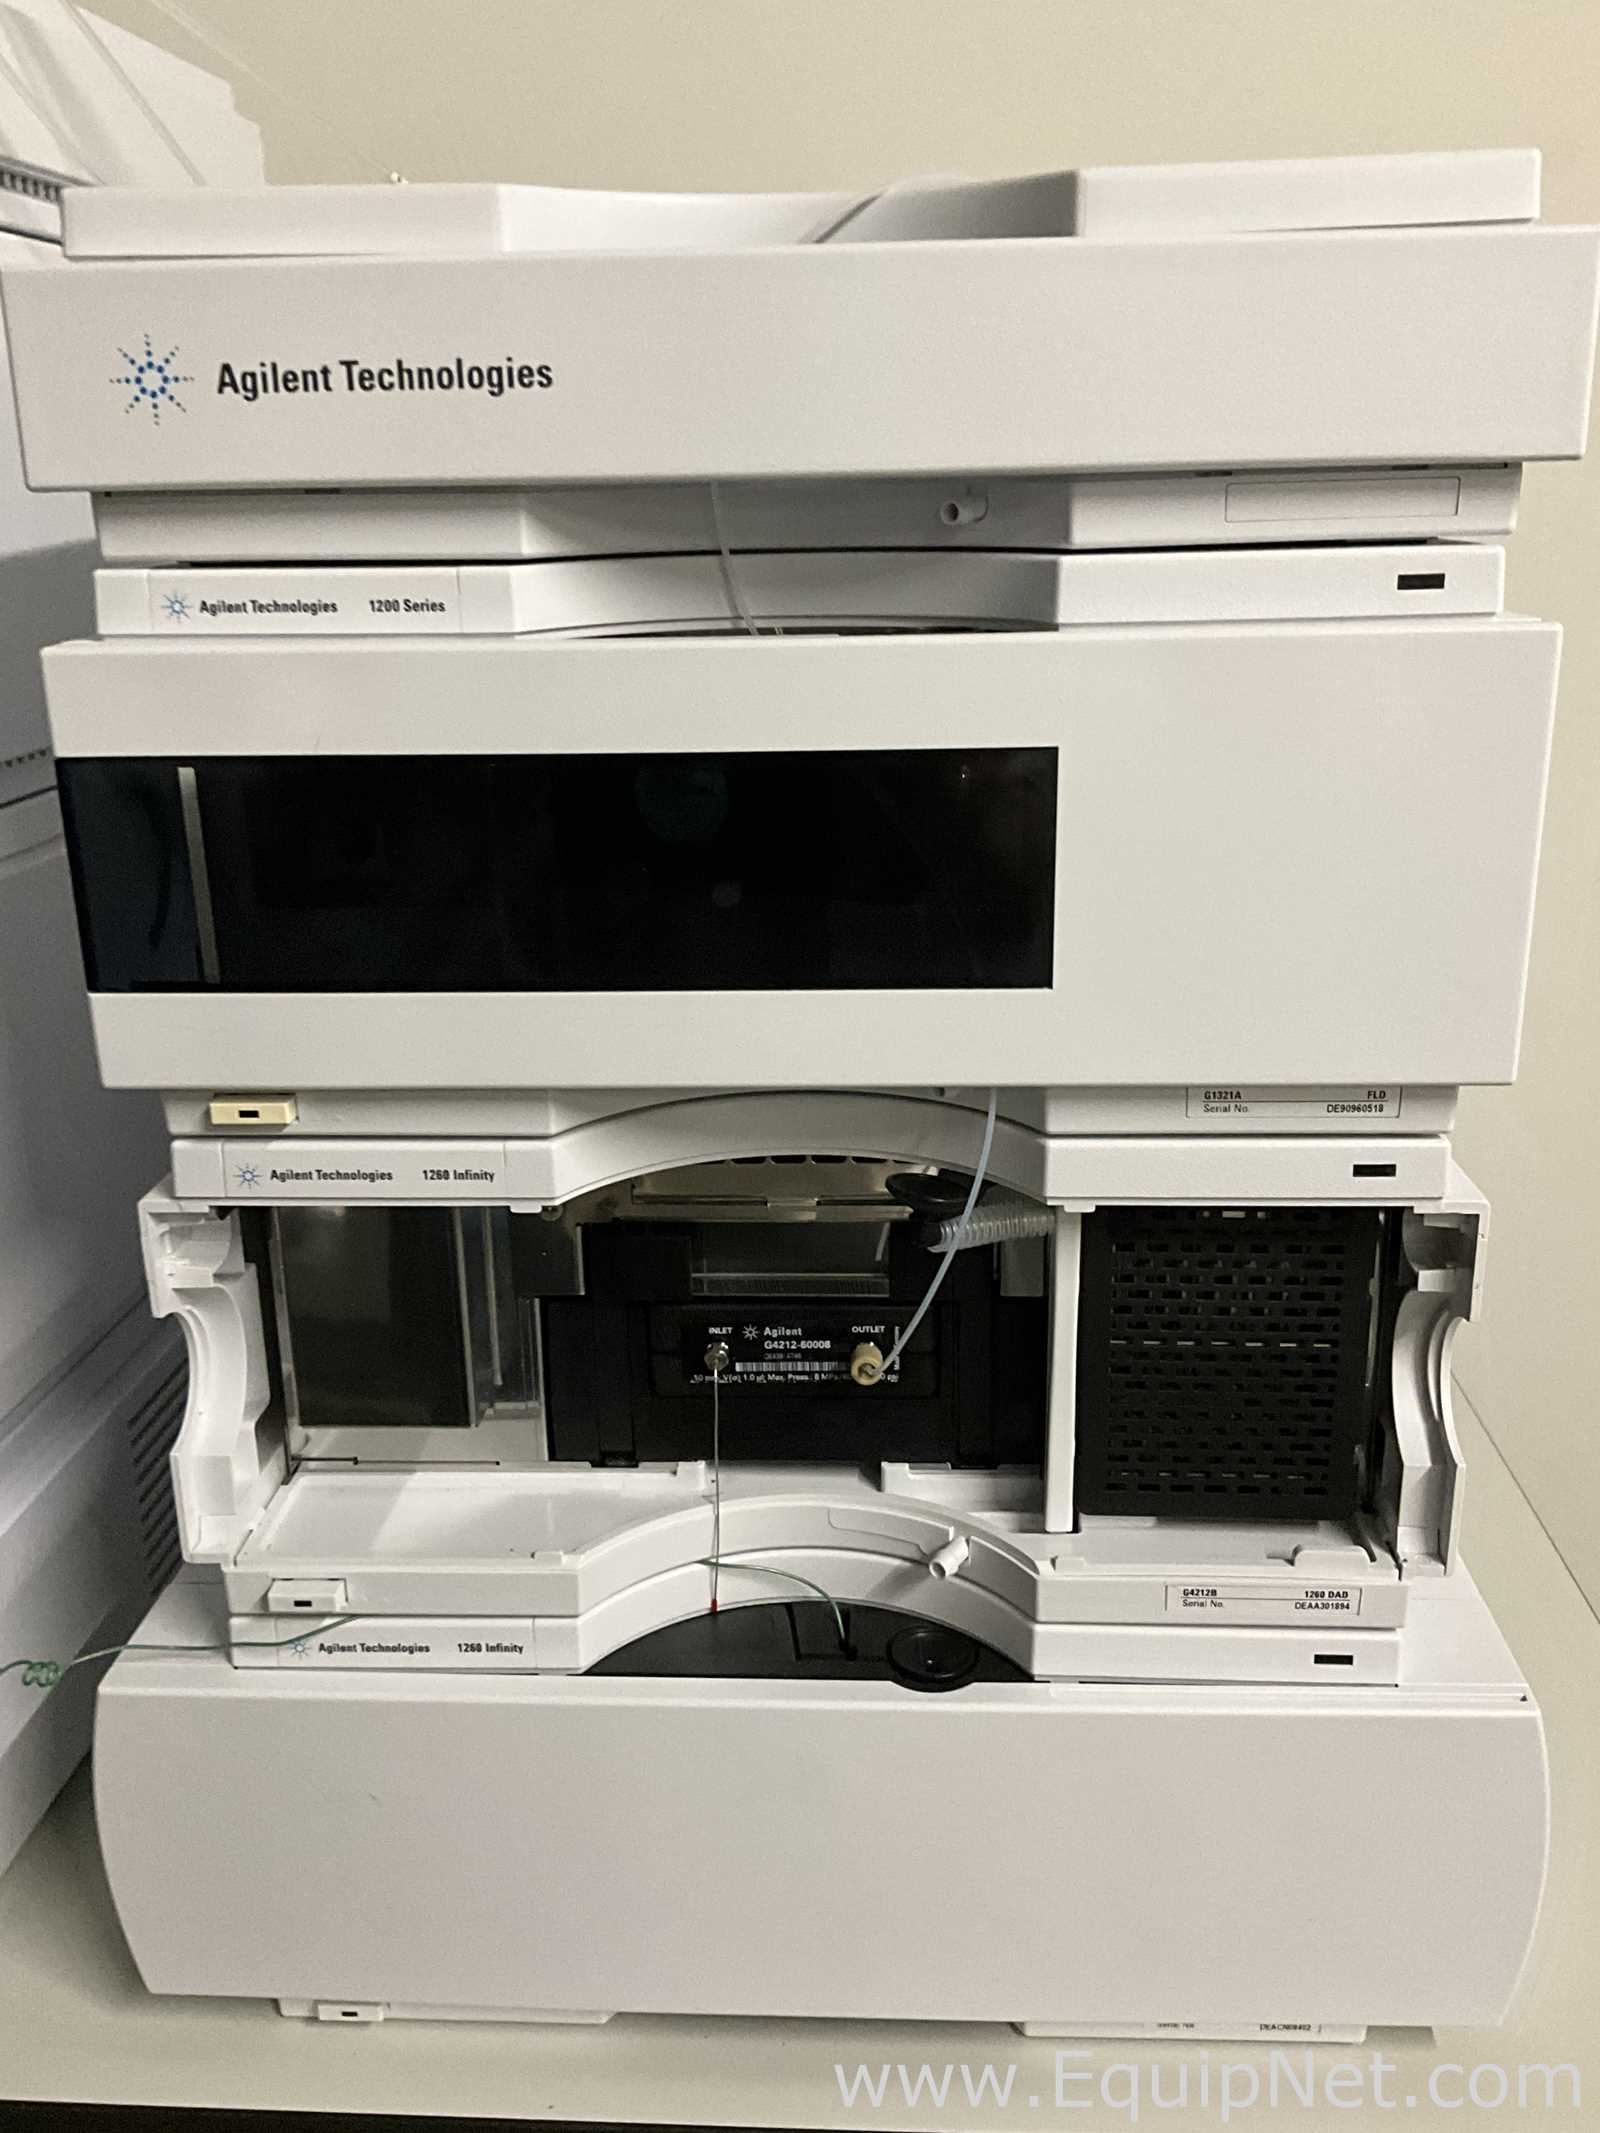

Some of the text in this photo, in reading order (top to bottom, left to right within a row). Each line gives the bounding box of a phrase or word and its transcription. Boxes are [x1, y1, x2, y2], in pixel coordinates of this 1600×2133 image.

[217, 356, 553, 402] Agilent Technologies
[200, 598, 446, 616] Agilent Technologies 1200 Series
[1203, 1090, 1386, 1100] G1321A FLD
[1203, 1104, 1232, 1113] Serial
[270, 1169, 495, 1183] Agilent Technologies 1260 Infinity
[708, 1326, 733, 1335] INLET
[763, 1326, 803, 1338] Agilent
[851, 1325, 886, 1334] OUTLET
[1328, 1590, 1349, 1599] DAD
[1182, 1599, 1208, 1608] Serial
[318, 1643, 524, 1655] Agilent Technologies 1260 Infinity
